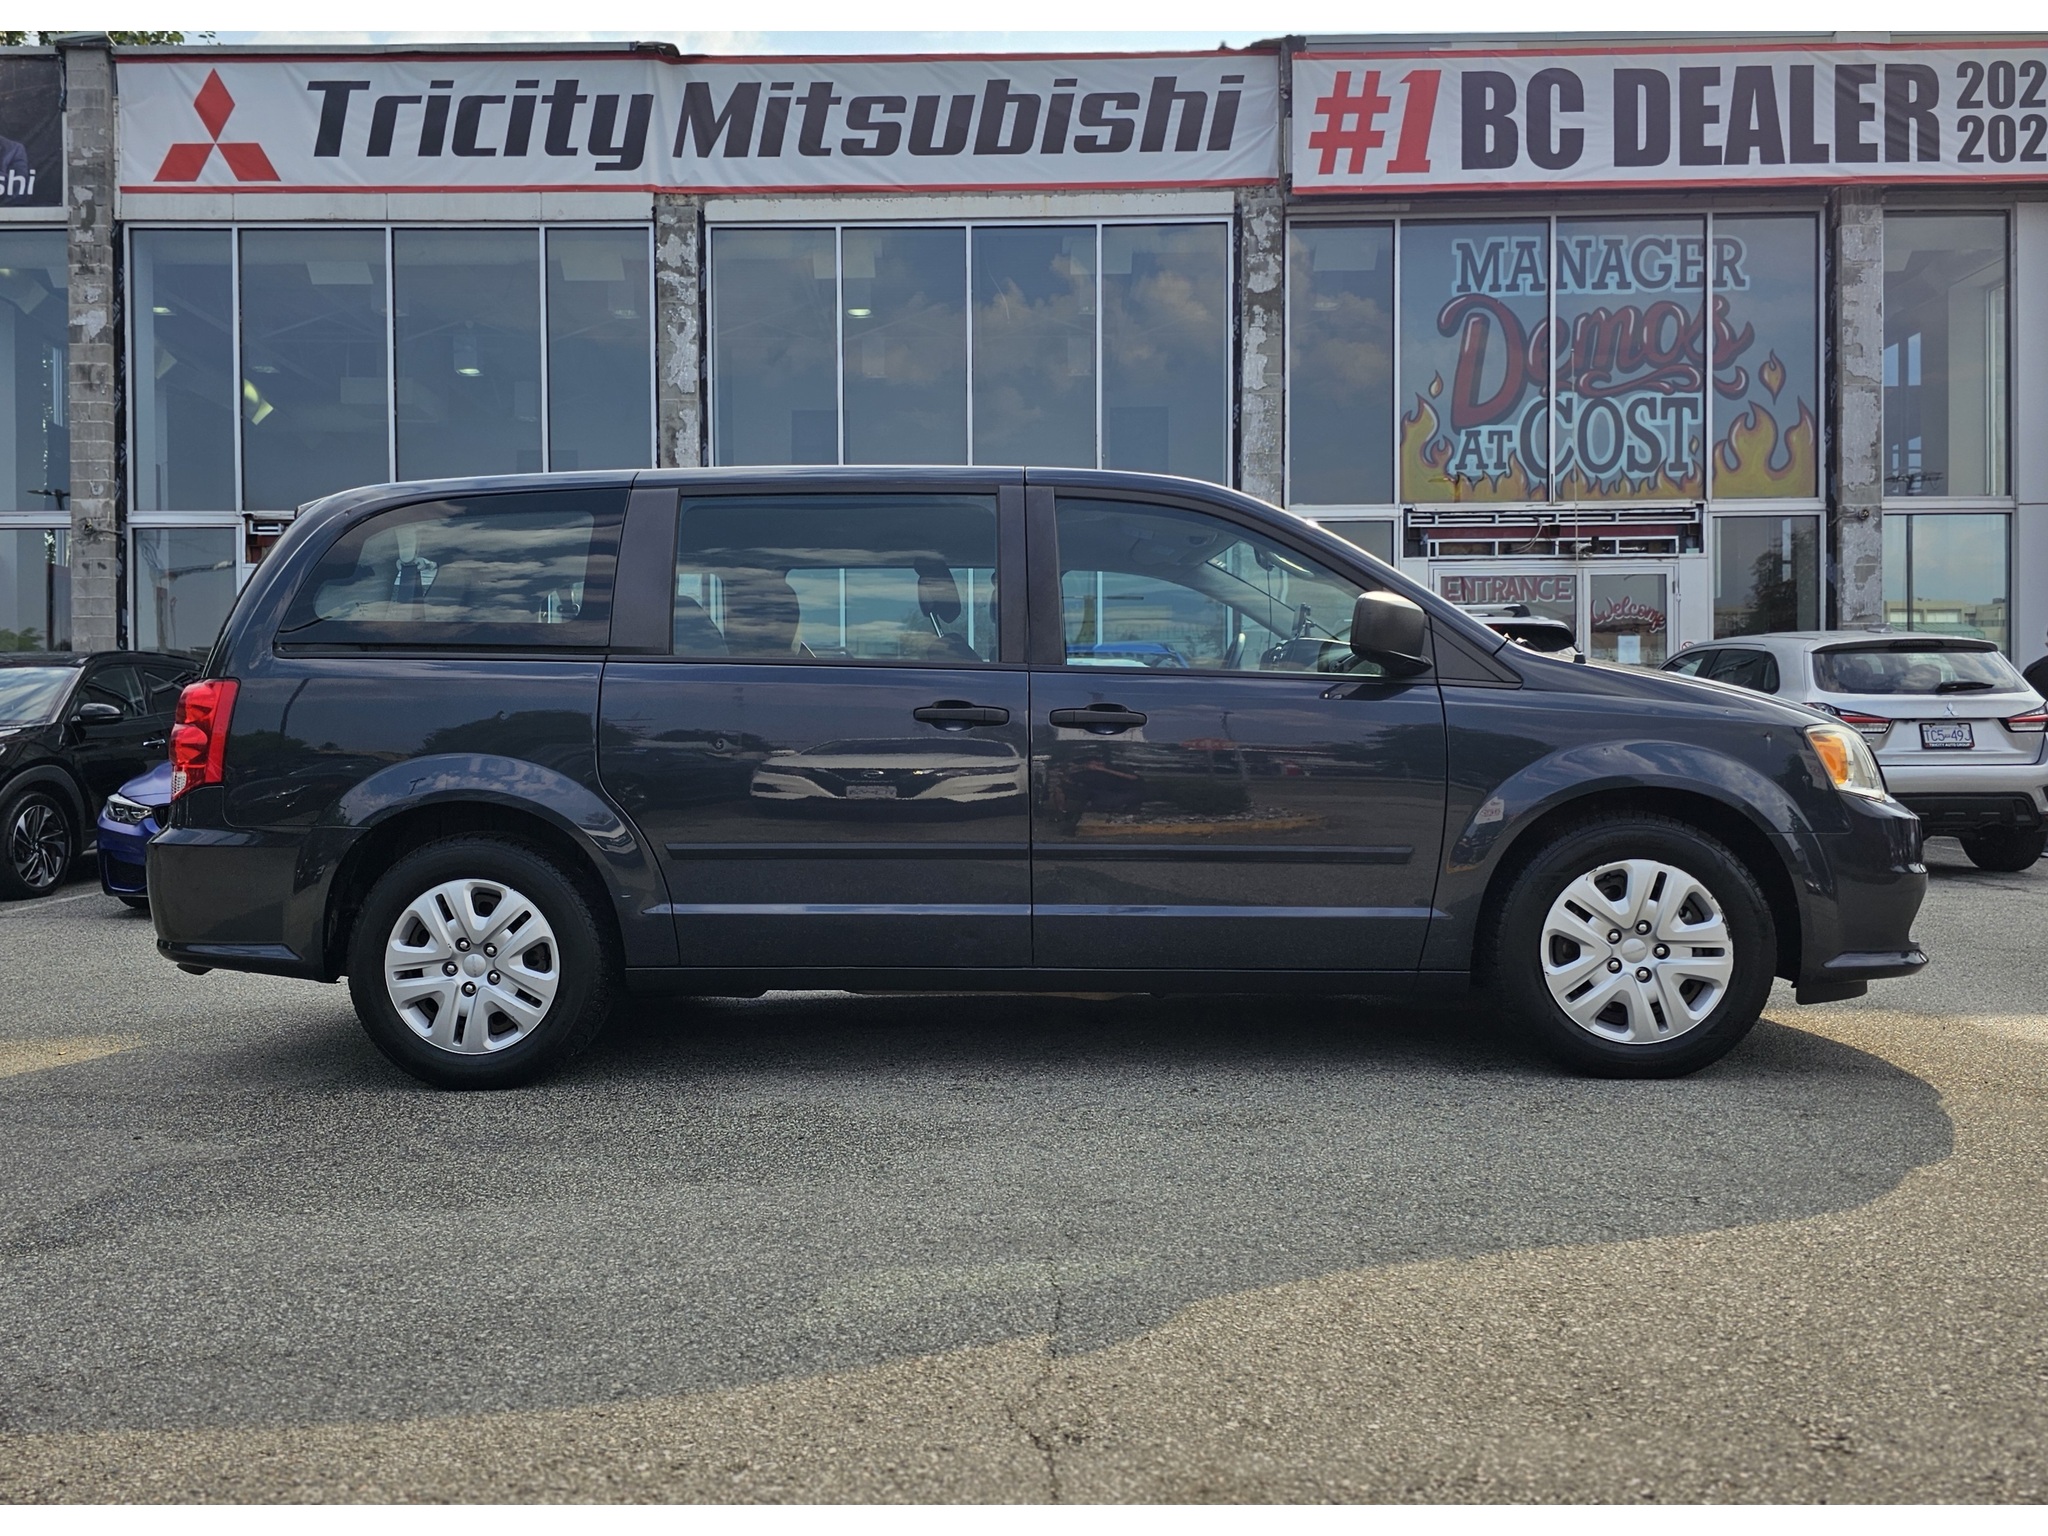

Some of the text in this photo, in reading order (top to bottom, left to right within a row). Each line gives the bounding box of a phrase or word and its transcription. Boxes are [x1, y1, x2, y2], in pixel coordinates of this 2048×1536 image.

[307, 75, 1245, 171] Tricity Mitsubishi
[1307, 62, 1941, 175] #1 BC DEALER
[1454, 236, 1748, 294] MANAGER
[1437, 293, 1755, 433] Demos
[1453, 396, 1699, 478] AT COST
[1443, 576, 1575, 604] ENTRANCE
[1590, 596, 1666, 633] Welcome
